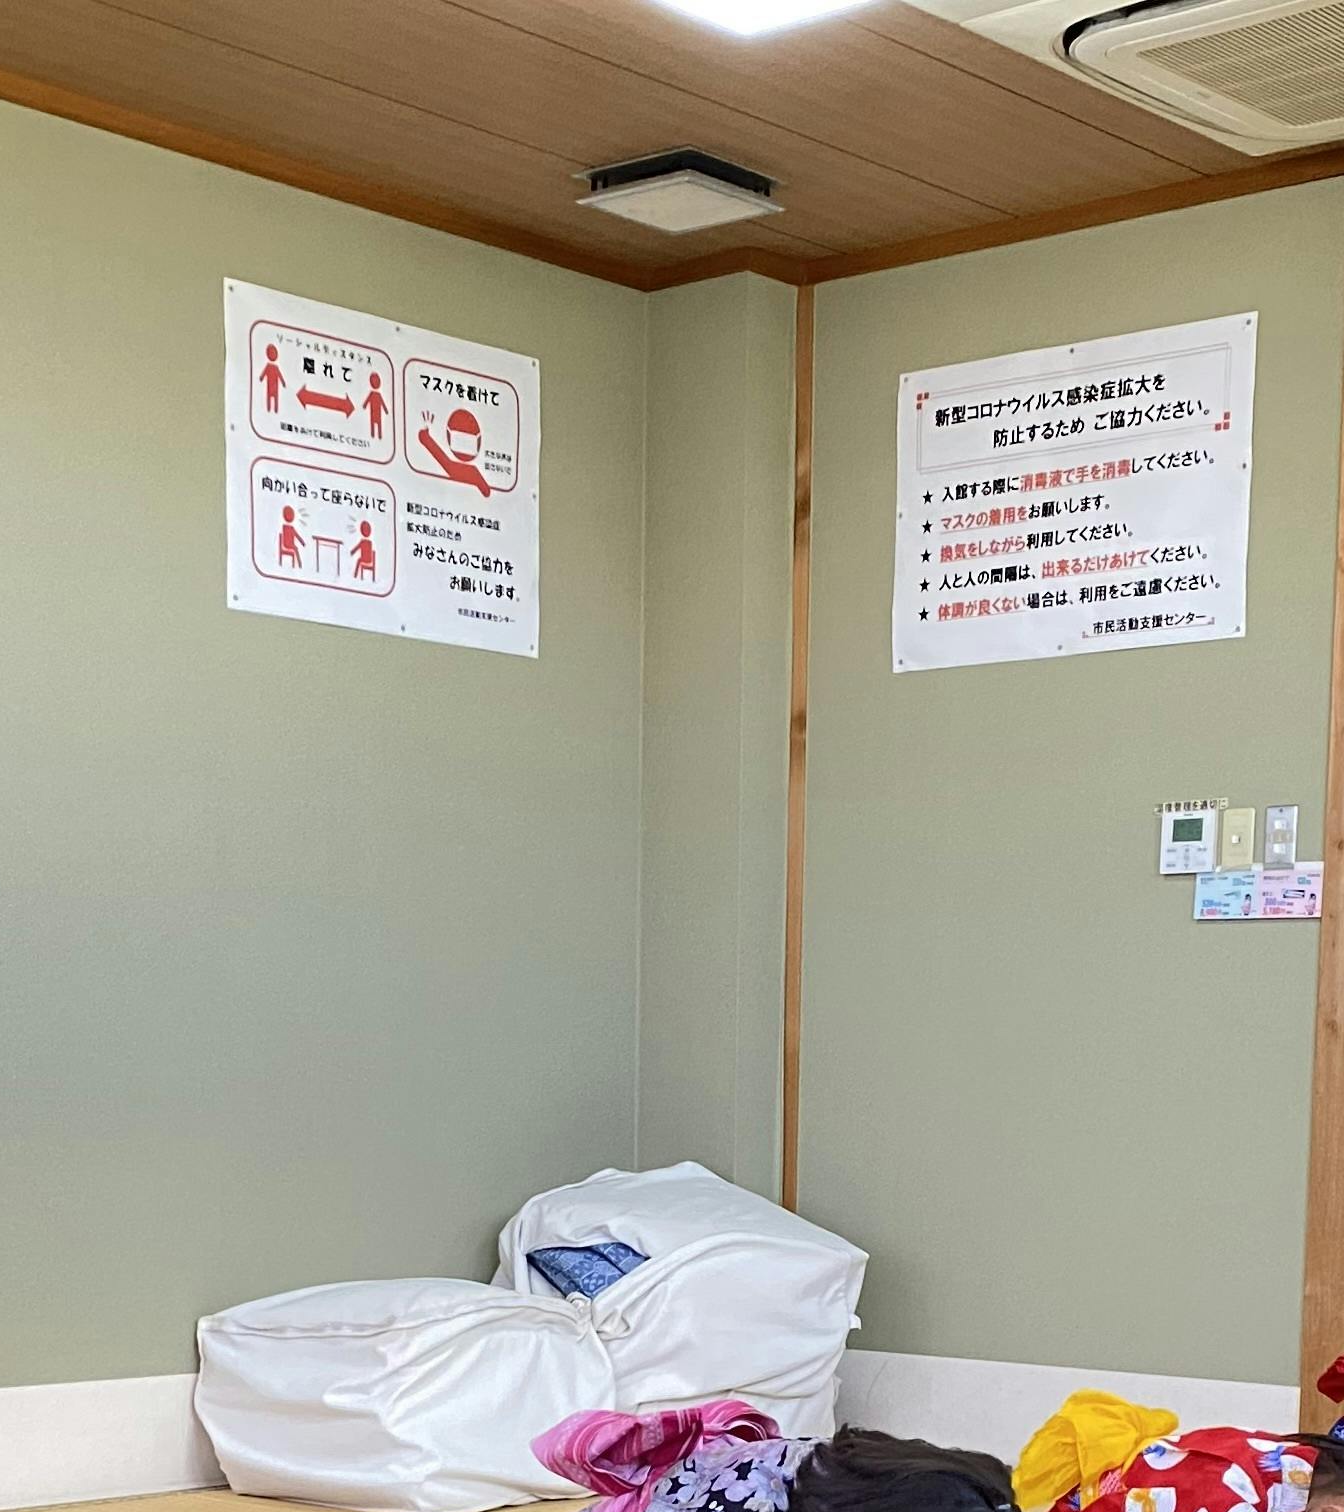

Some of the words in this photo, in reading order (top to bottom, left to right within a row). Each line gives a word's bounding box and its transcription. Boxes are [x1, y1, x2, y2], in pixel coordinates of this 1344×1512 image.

[419, 374, 500, 406] マスクを着けて
[935, 374, 1166, 427] 新型コロナウイルス感染症拡大を
[993, 417, 1085, 448] 防止するため
[1094, 399, 1210, 431] ご協力ください。
[262, 476, 387, 513] 向かい合って座らないで
[941, 493, 1110, 530] マスクの着用をお願いします。
[406, 502, 501, 531] 新型コロナウイルス感染症
[413, 542, 514, 575] みなさんのご協力を
[940, 523, 1133, 562] 換気をしながら利用してください。
[449, 576, 520, 602] お願いします。
[1093, 612, 1207, 635] 市民活動支援センター
